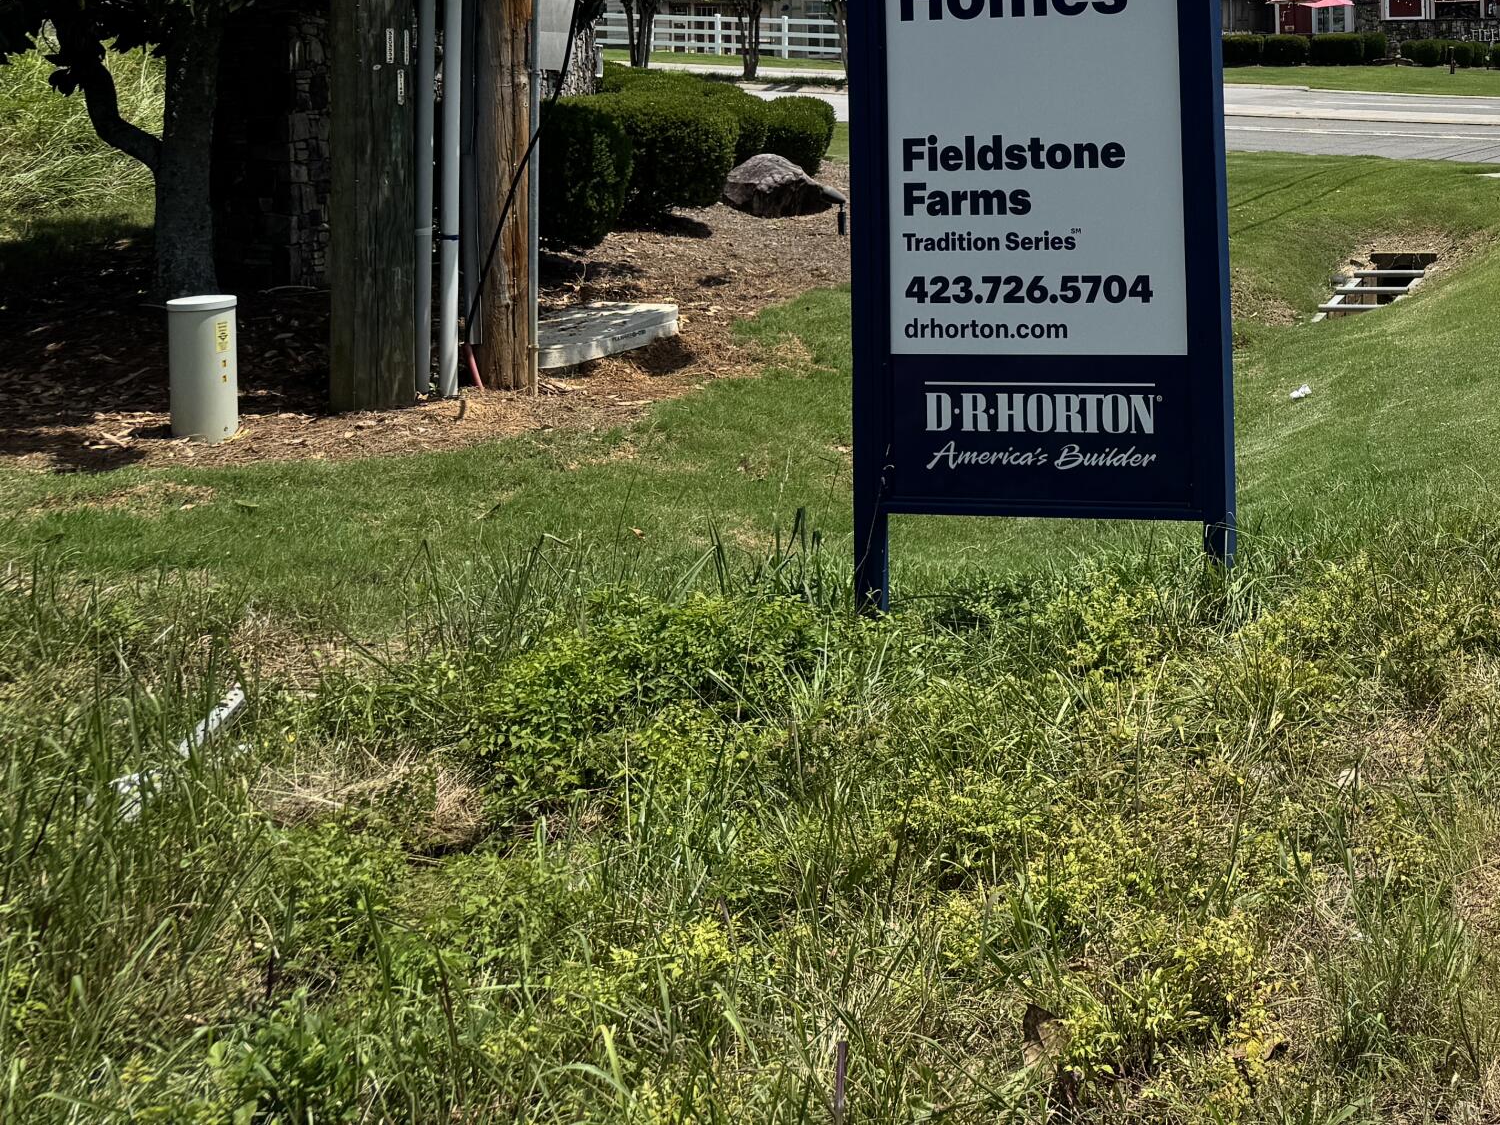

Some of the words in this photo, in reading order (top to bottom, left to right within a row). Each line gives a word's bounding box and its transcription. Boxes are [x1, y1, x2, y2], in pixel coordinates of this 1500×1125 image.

[902, 134, 1126, 172] Fieldstone
[903, 182, 1032, 217] Farms
[902, 231, 1001, 252] Tradition
[1005, 230, 1077, 252] Series
[904, 275, 1154, 305] 423.726.5704
[904, 318, 1069, 340] drhorton.com
[926, 440, 1049, 471] America's
[1053, 443, 1157, 471] Builder
